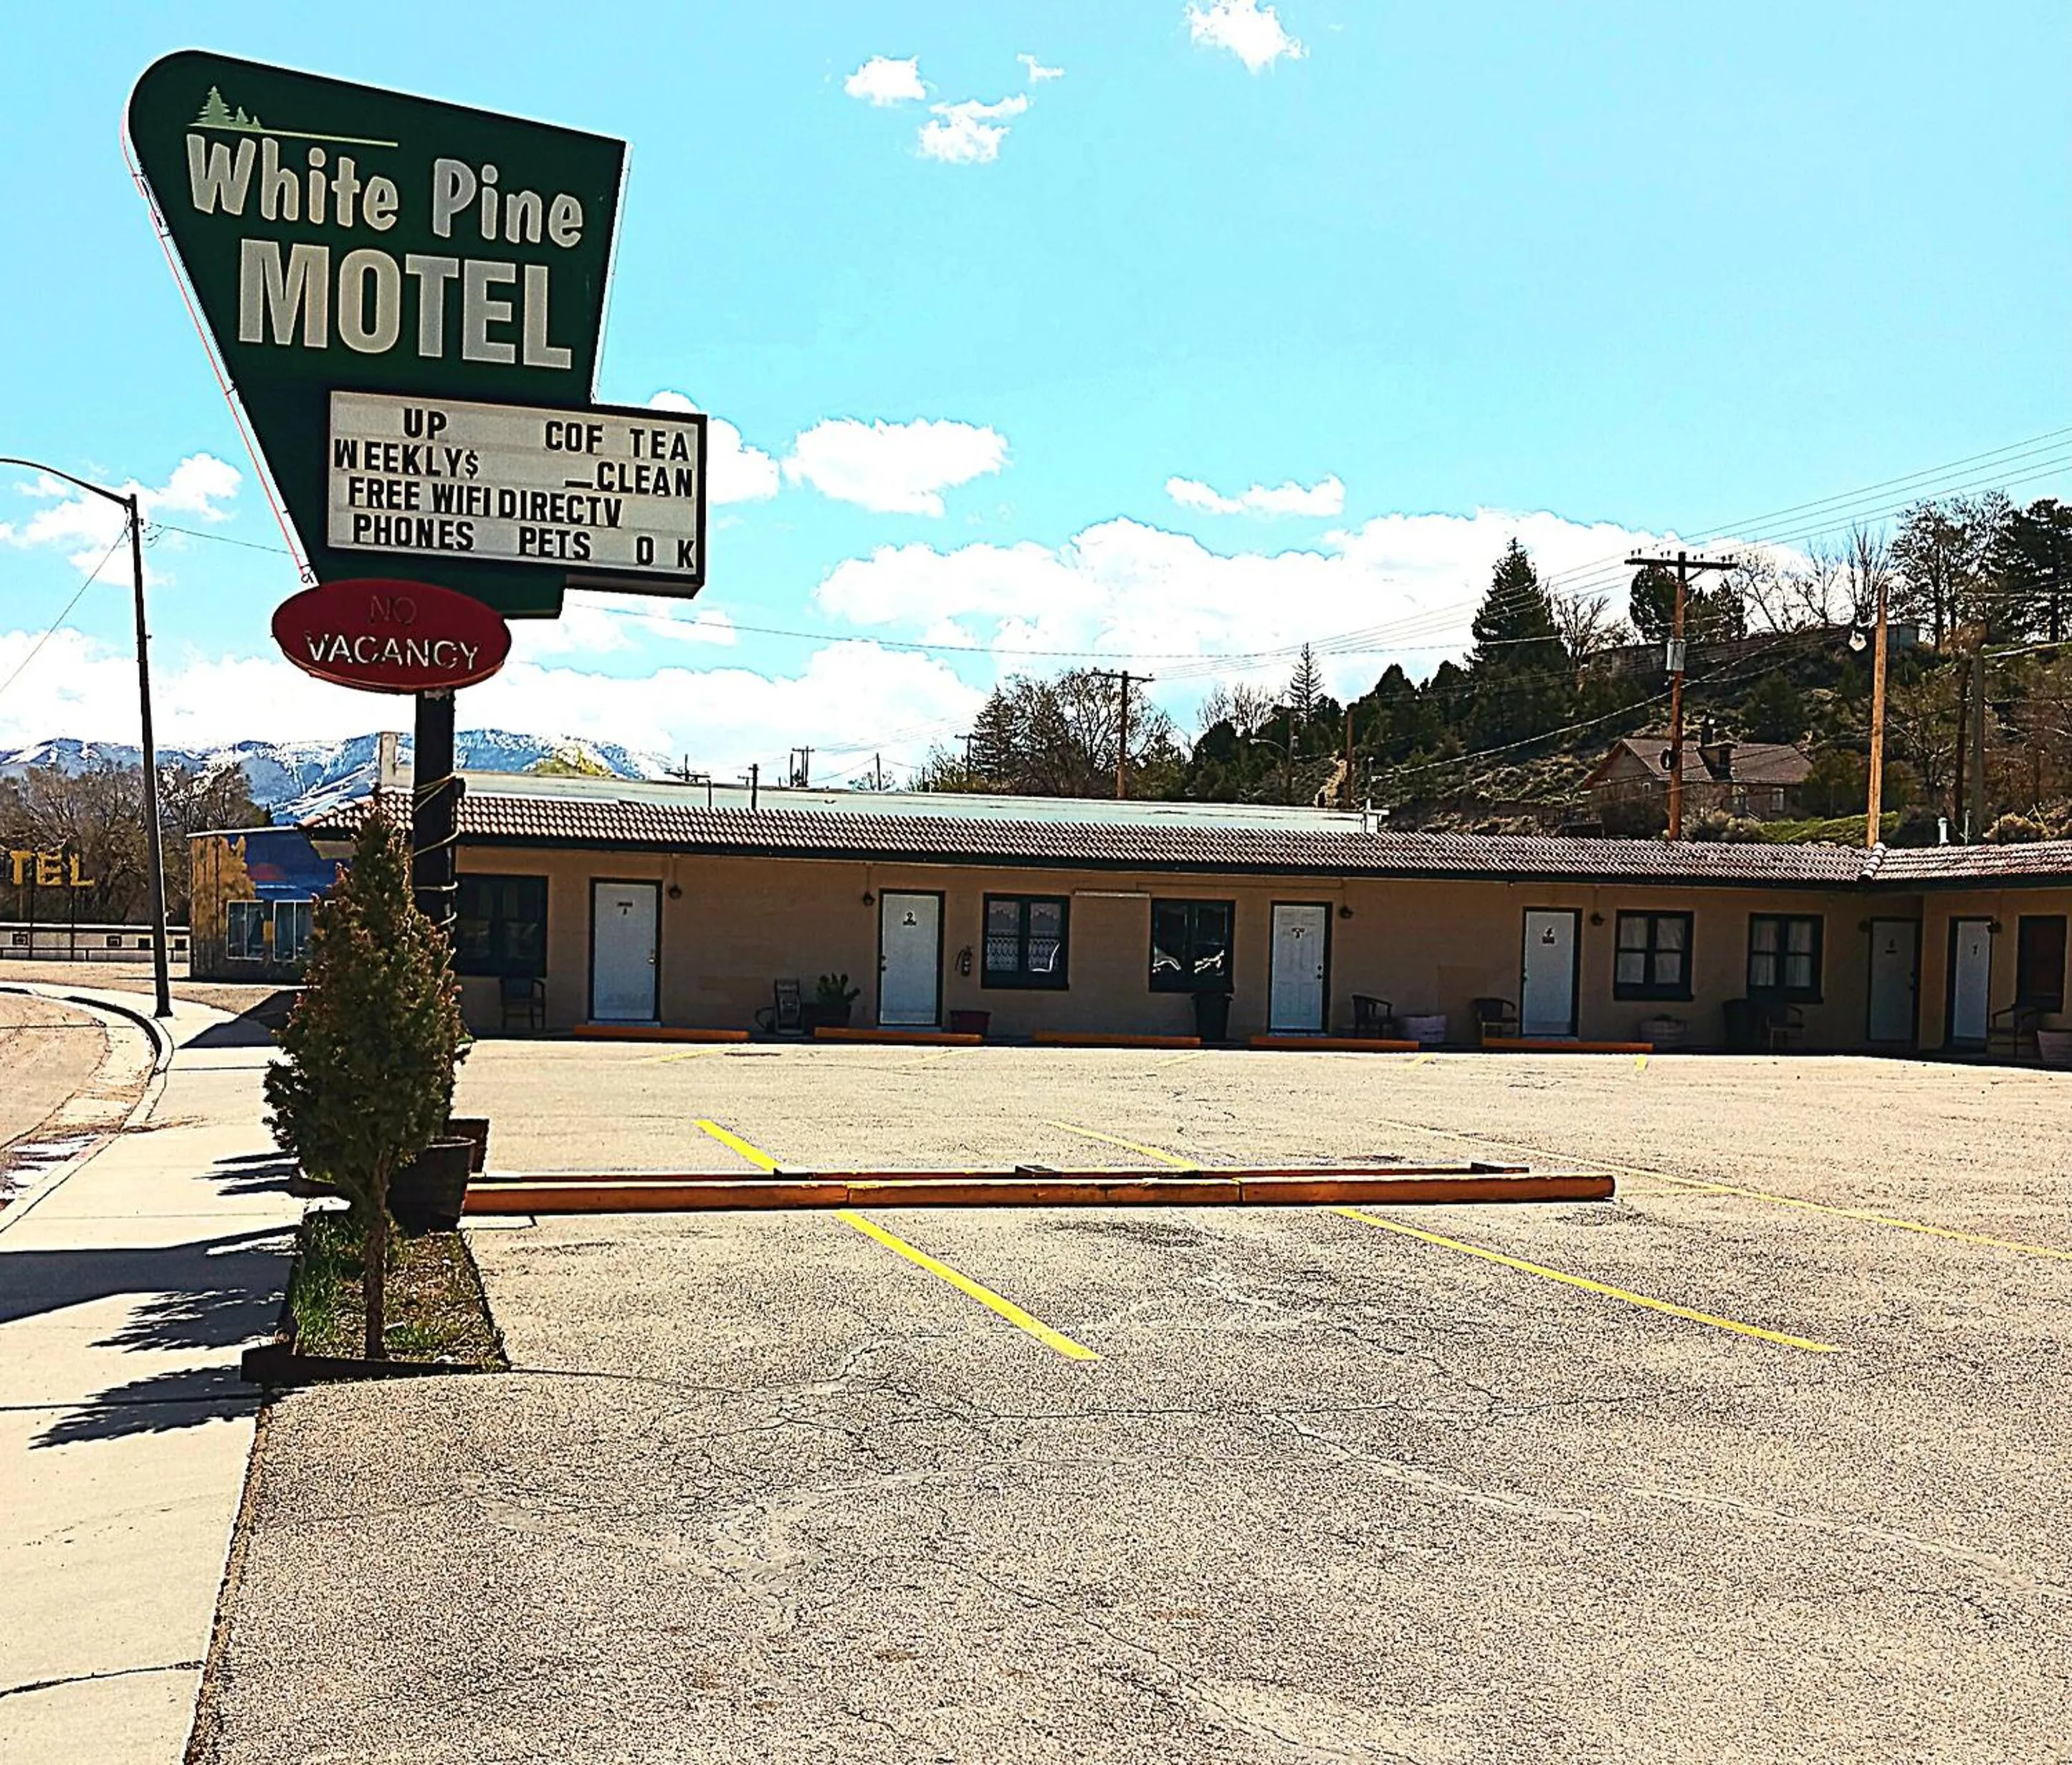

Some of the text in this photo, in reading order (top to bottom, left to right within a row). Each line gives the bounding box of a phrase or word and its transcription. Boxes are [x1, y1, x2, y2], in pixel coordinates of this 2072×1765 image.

[186, 133, 583, 247] White Pine
[238, 238, 572, 369] MOTEL
[333, 439, 479, 479] WEEKLY$
[404, 408, 689, 461] UP COF TEA
[349, 476, 622, 528] FREE WIFI DIRECTV
[353, 513, 474, 550] PHONES
[519, 526, 591, 561] PETS
[305, 594, 481, 670] NO VACANCY
[907, 912, 914, 922] 2
